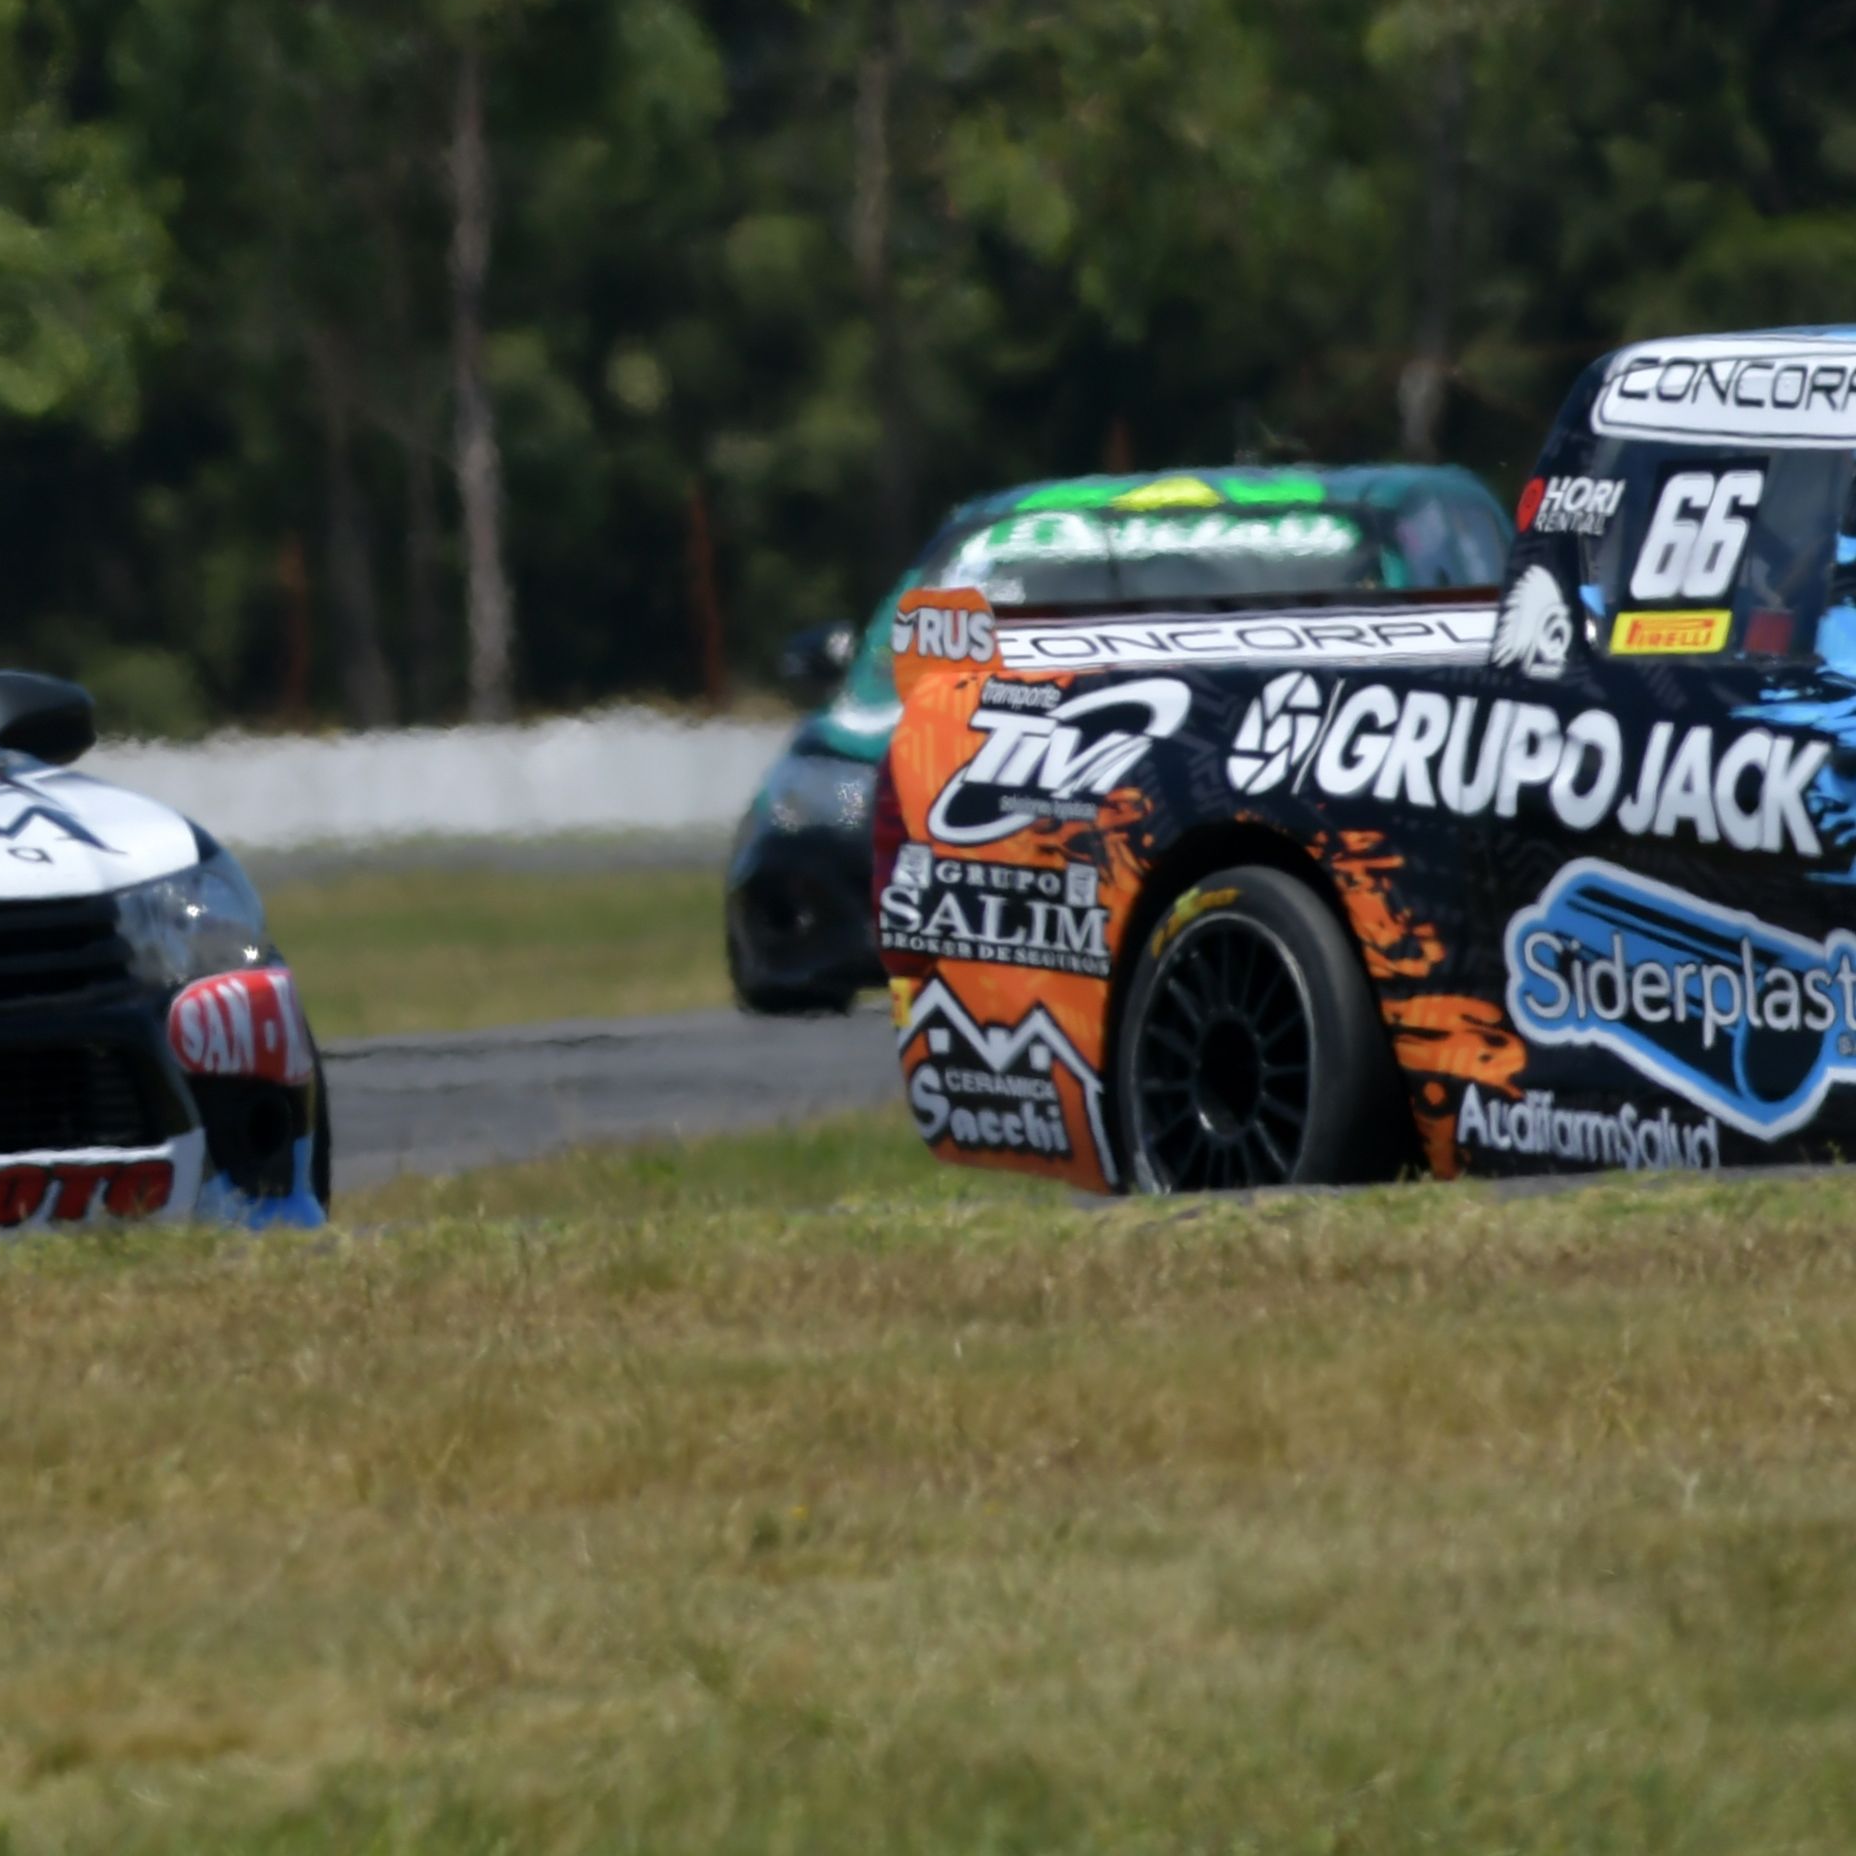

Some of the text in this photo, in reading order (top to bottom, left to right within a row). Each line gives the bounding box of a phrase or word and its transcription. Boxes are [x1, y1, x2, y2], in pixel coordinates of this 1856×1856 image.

[1540, 476, 1626, 519] HORI
[1630, 470, 1766, 600] 66
[918, 607, 995, 663] RUS
[1626, 619, 1715, 647] PIRELLI
[935, 860, 1062, 895] GRUPO
[880, 885, 1111, 957] SALIM
[882, 931, 975, 960] BROKER
